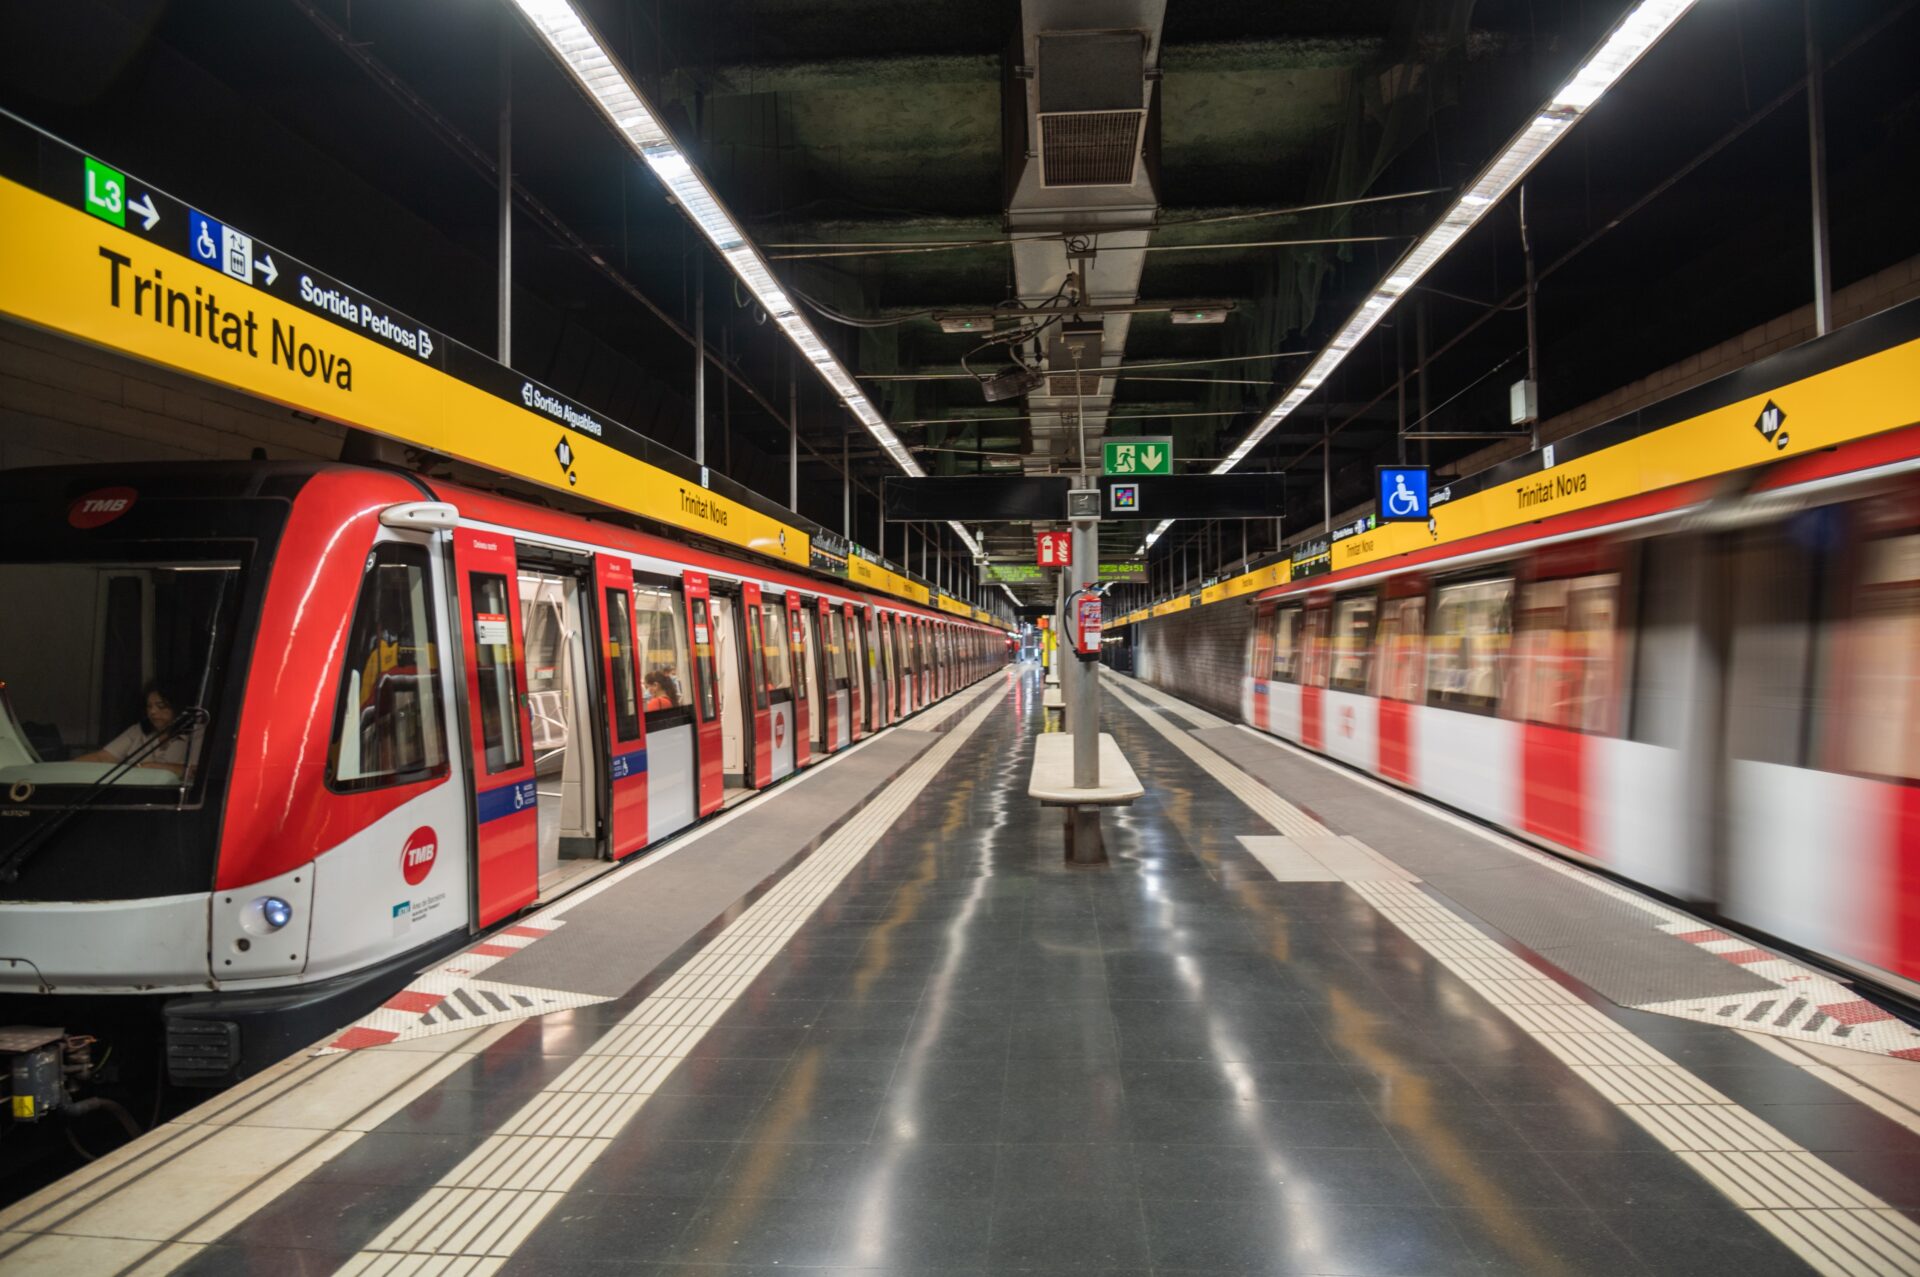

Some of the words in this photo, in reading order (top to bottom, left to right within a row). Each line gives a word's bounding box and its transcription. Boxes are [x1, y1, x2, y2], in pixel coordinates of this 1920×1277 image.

[88, 170, 122, 213] L3
[99, 246, 258, 358] Trinitat
[272, 318, 352, 392] Nova
[300, 275, 358, 323] Sortida
[361, 304, 416, 350] Pedrosa
[534, 390, 562, 418] Sortida
[563, 404, 602, 437] Aiguablava
[1763, 408, 1777, 433] M
[559, 443, 570, 465] M
[82, 499, 128, 512] TMB
[680, 488, 708, 520] Trinitat
[709, 501, 727, 526] Nova
[1517, 483, 1553, 509] Trinitat
[1556, 473, 1587, 498] Nova
[408, 844, 434, 866] TMB
